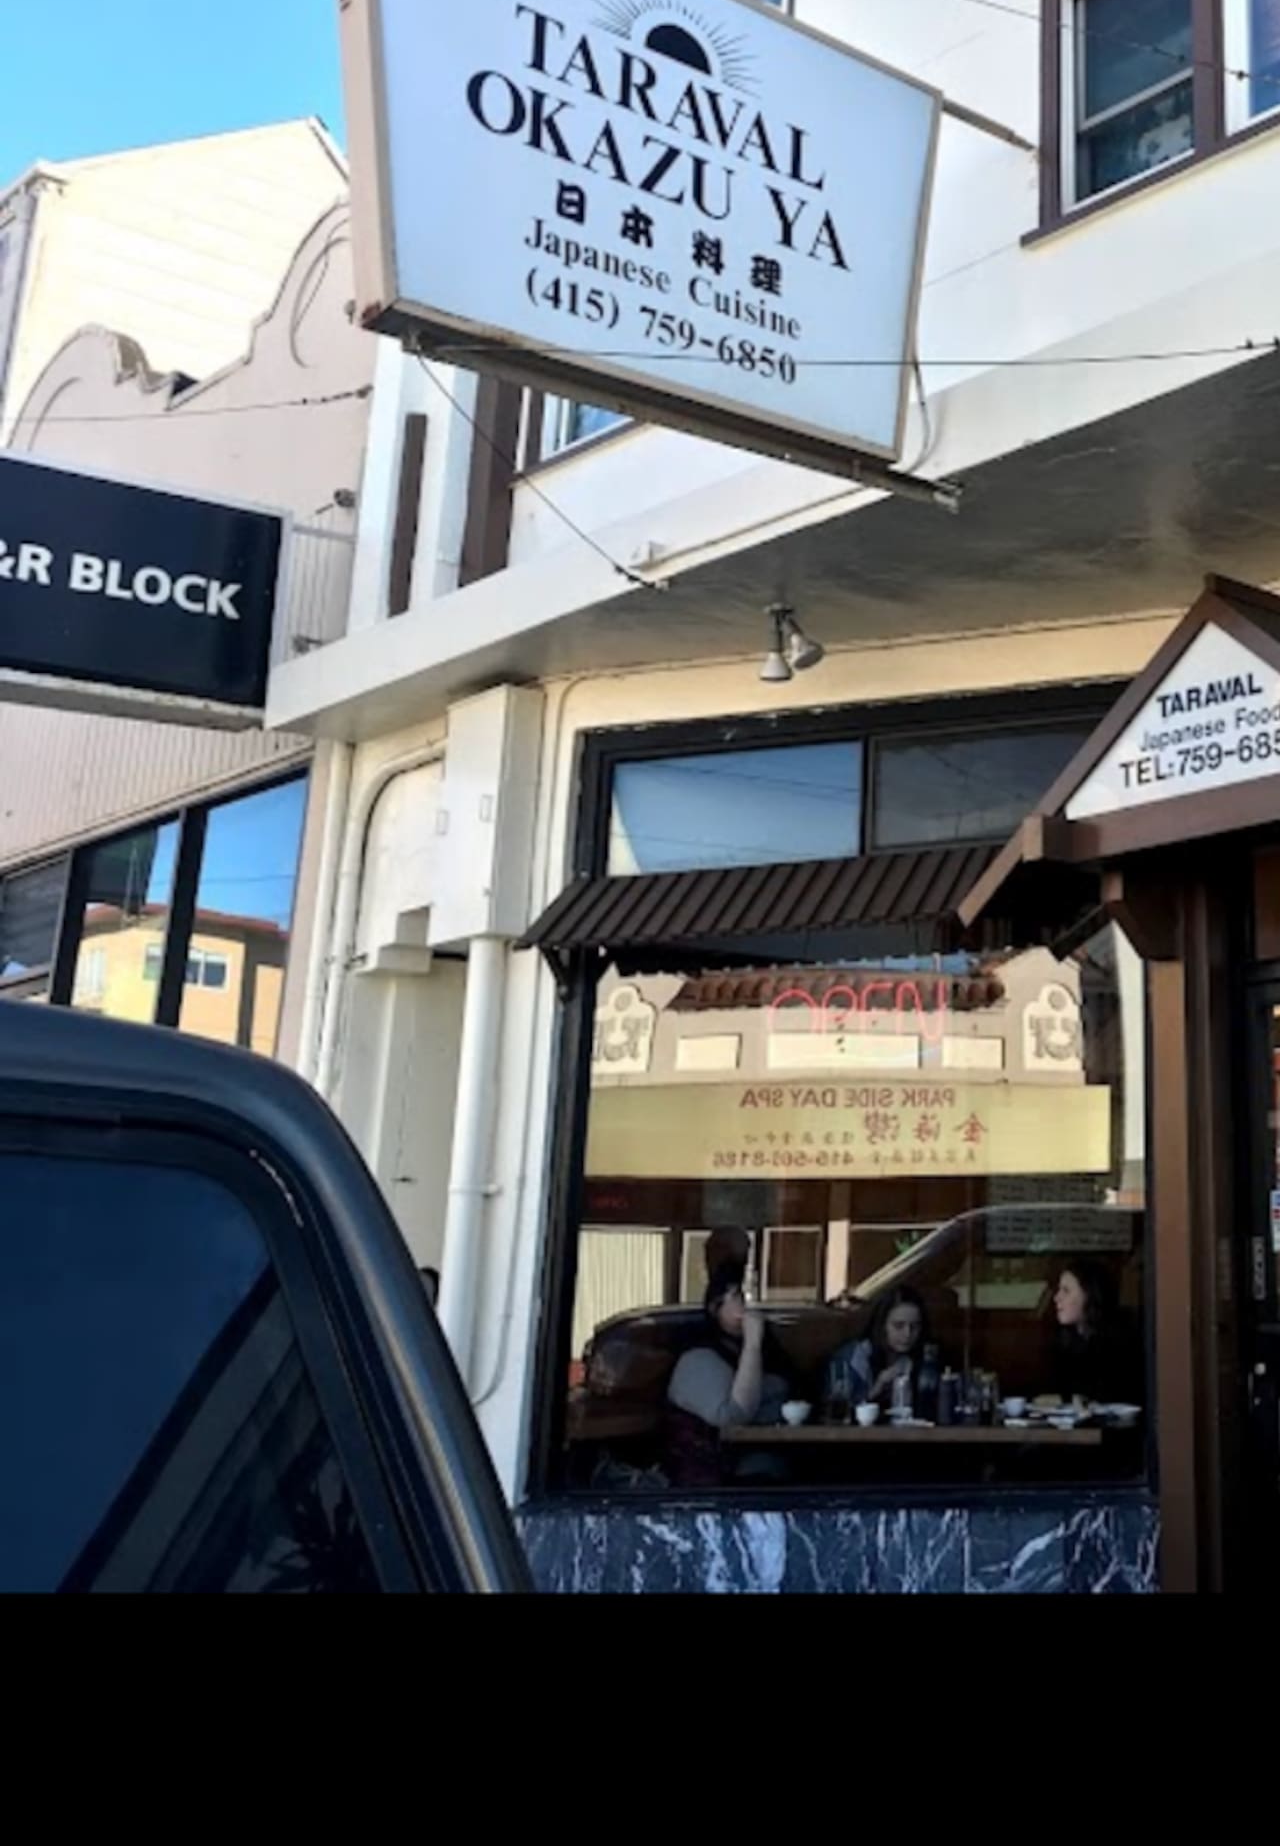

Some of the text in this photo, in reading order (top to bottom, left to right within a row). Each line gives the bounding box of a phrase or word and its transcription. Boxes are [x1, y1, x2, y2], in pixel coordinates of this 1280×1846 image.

[514, 3, 825, 191] TARAVAL
[466, 70, 851, 272] OKAZU YA
[524, 217, 802, 340] Japanese Cuisine
[555, 178, 783, 297] 日本料理
[526, 267, 797, 385] (415) 759-6850
[68, 553, 243, 620] BLOCK
[1139, 717, 1226, 752] Japanese
[1156, 672, 1263, 719] TARAVAL
